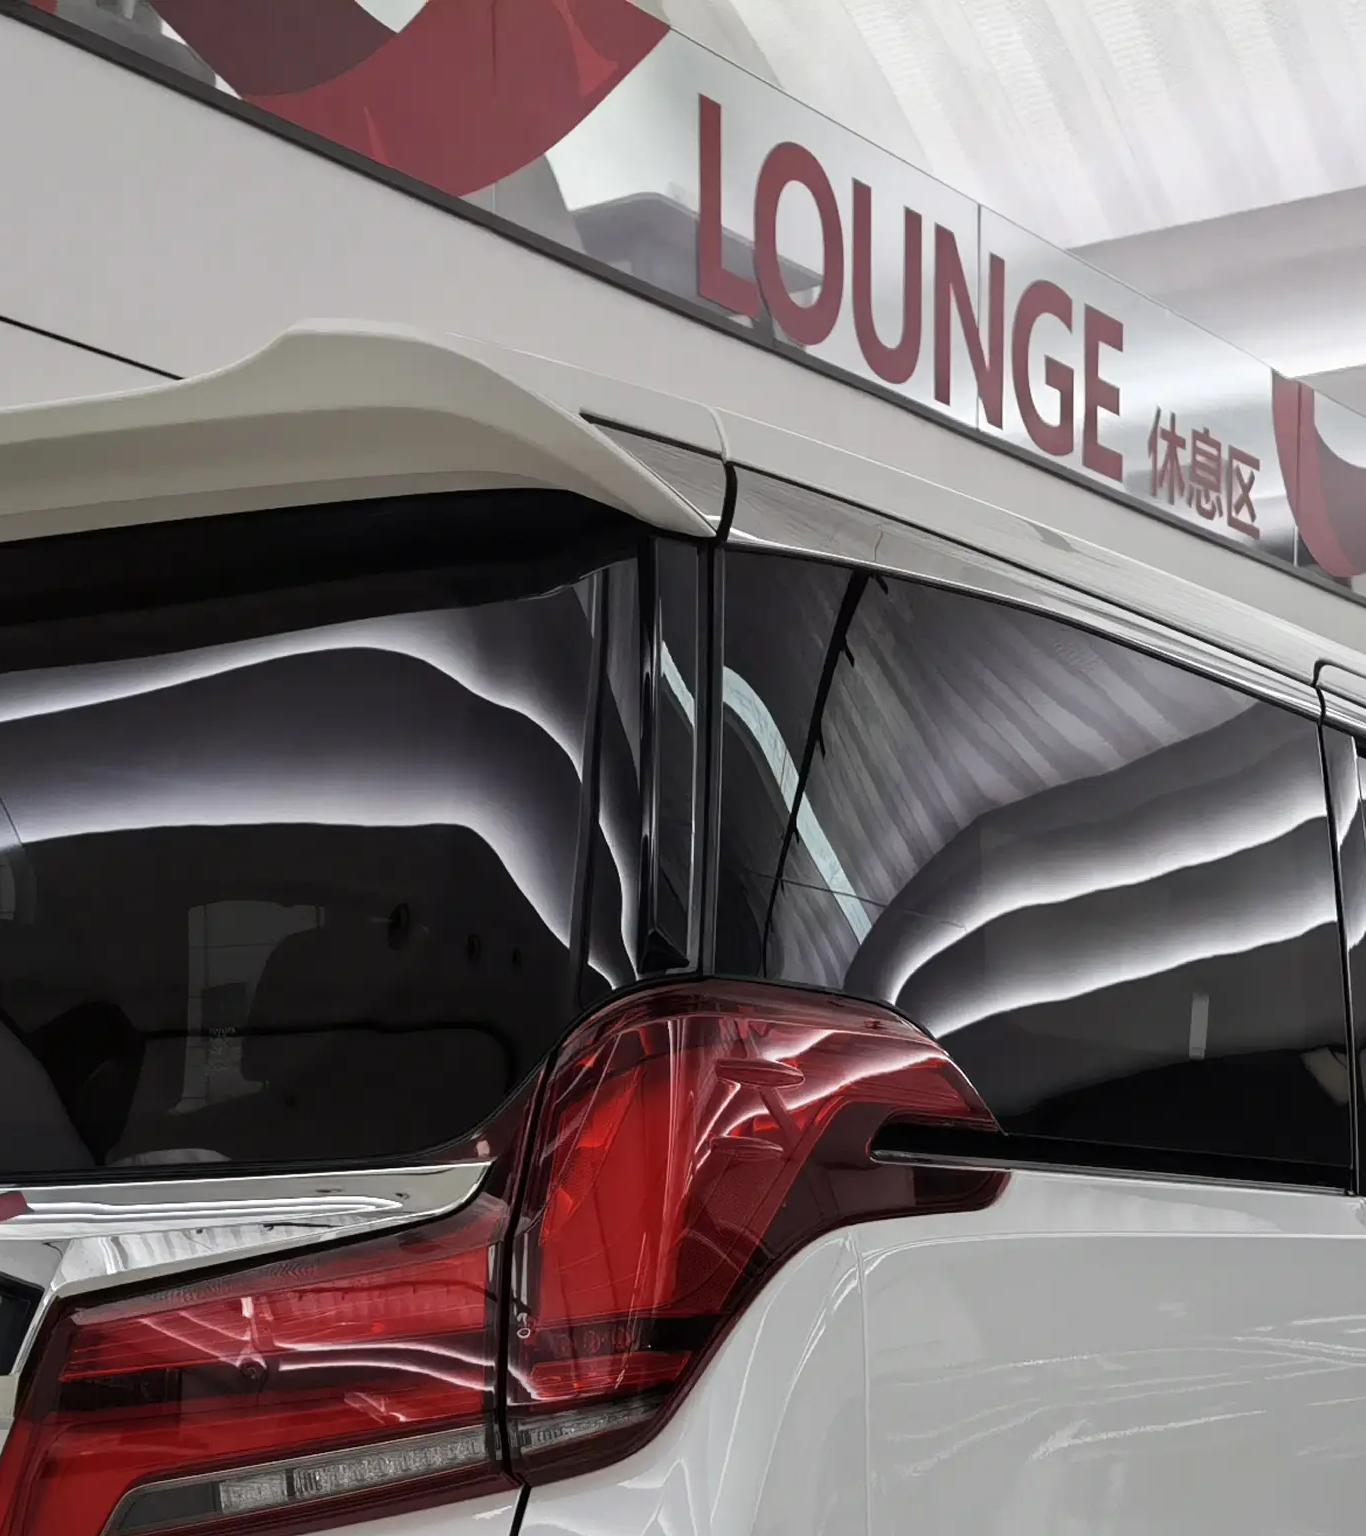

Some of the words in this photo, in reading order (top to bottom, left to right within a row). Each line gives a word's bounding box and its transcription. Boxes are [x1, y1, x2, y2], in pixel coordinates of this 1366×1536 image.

[696, 92, 1124, 483] LOUNGE
[1147, 404, 1260, 540] 休息区
